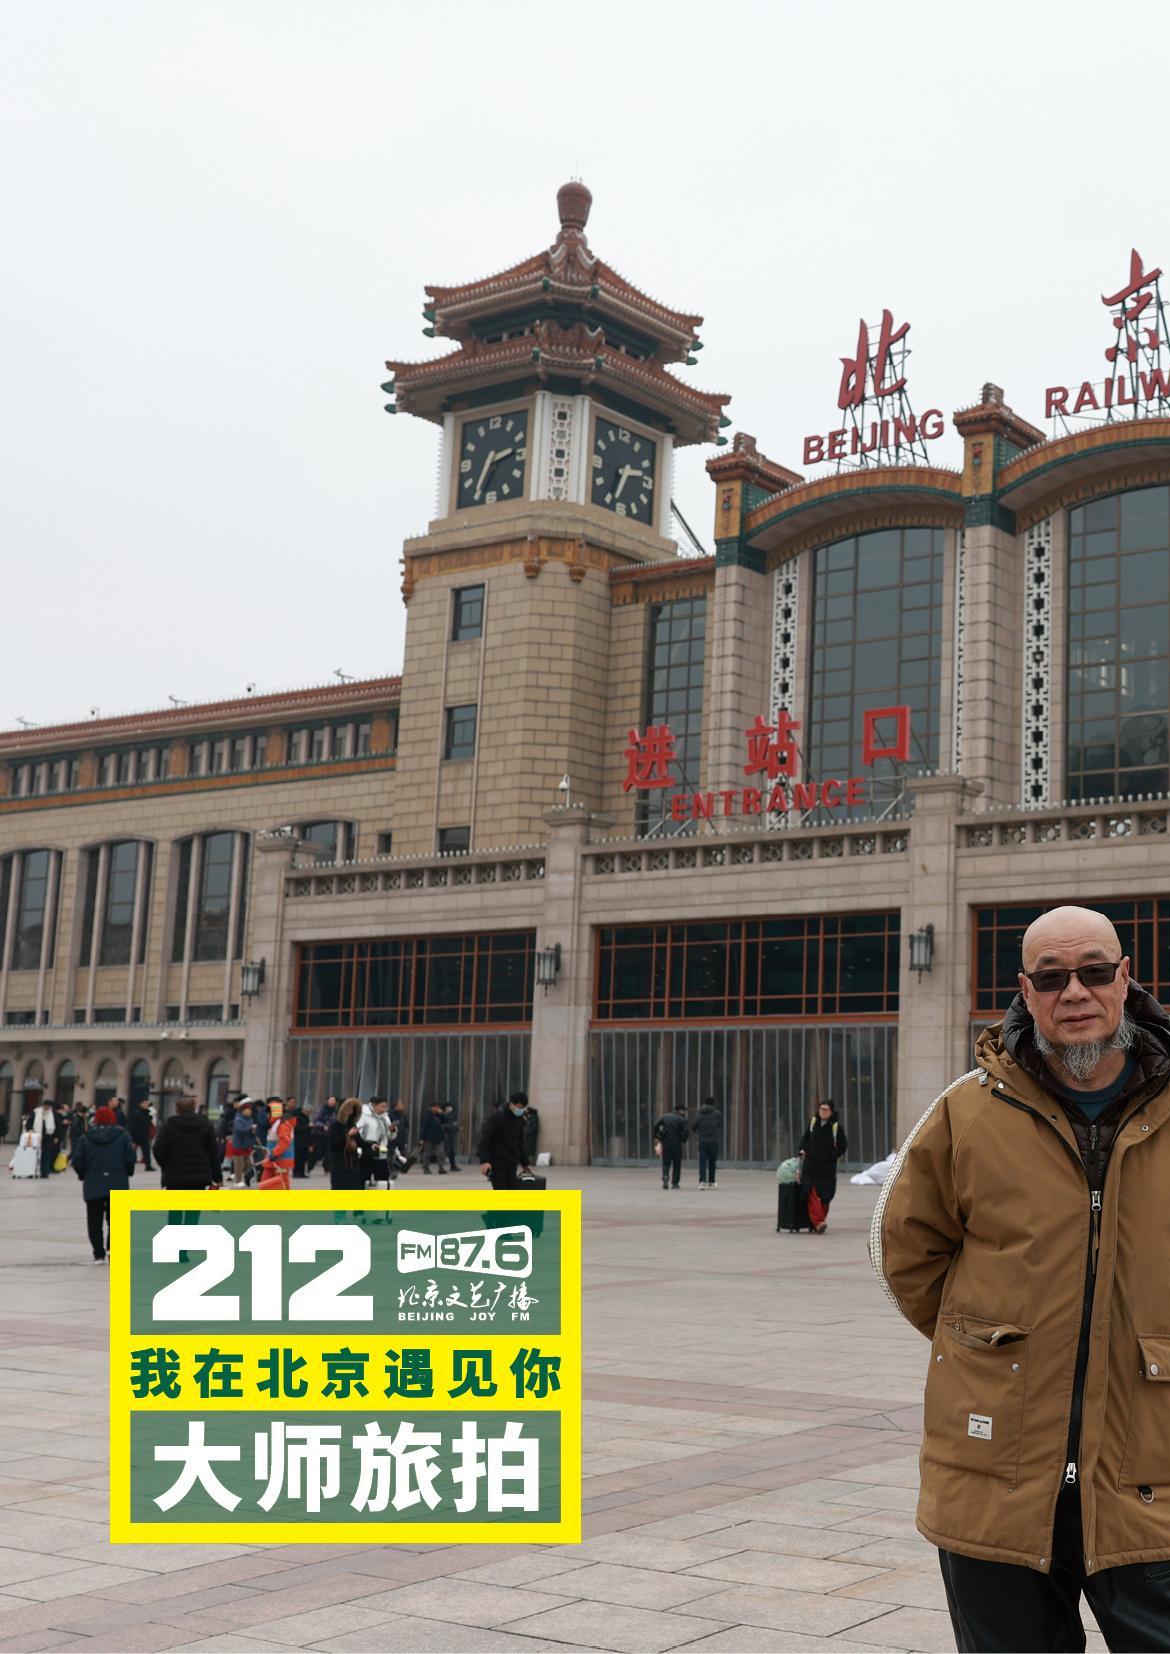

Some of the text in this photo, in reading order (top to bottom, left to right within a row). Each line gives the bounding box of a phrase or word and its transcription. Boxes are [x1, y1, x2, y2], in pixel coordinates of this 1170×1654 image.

[804, 409, 944, 465] BEIJING
[622, 705, 911, 793] 进站口
[671, 777, 866, 821] ENTRANCE
